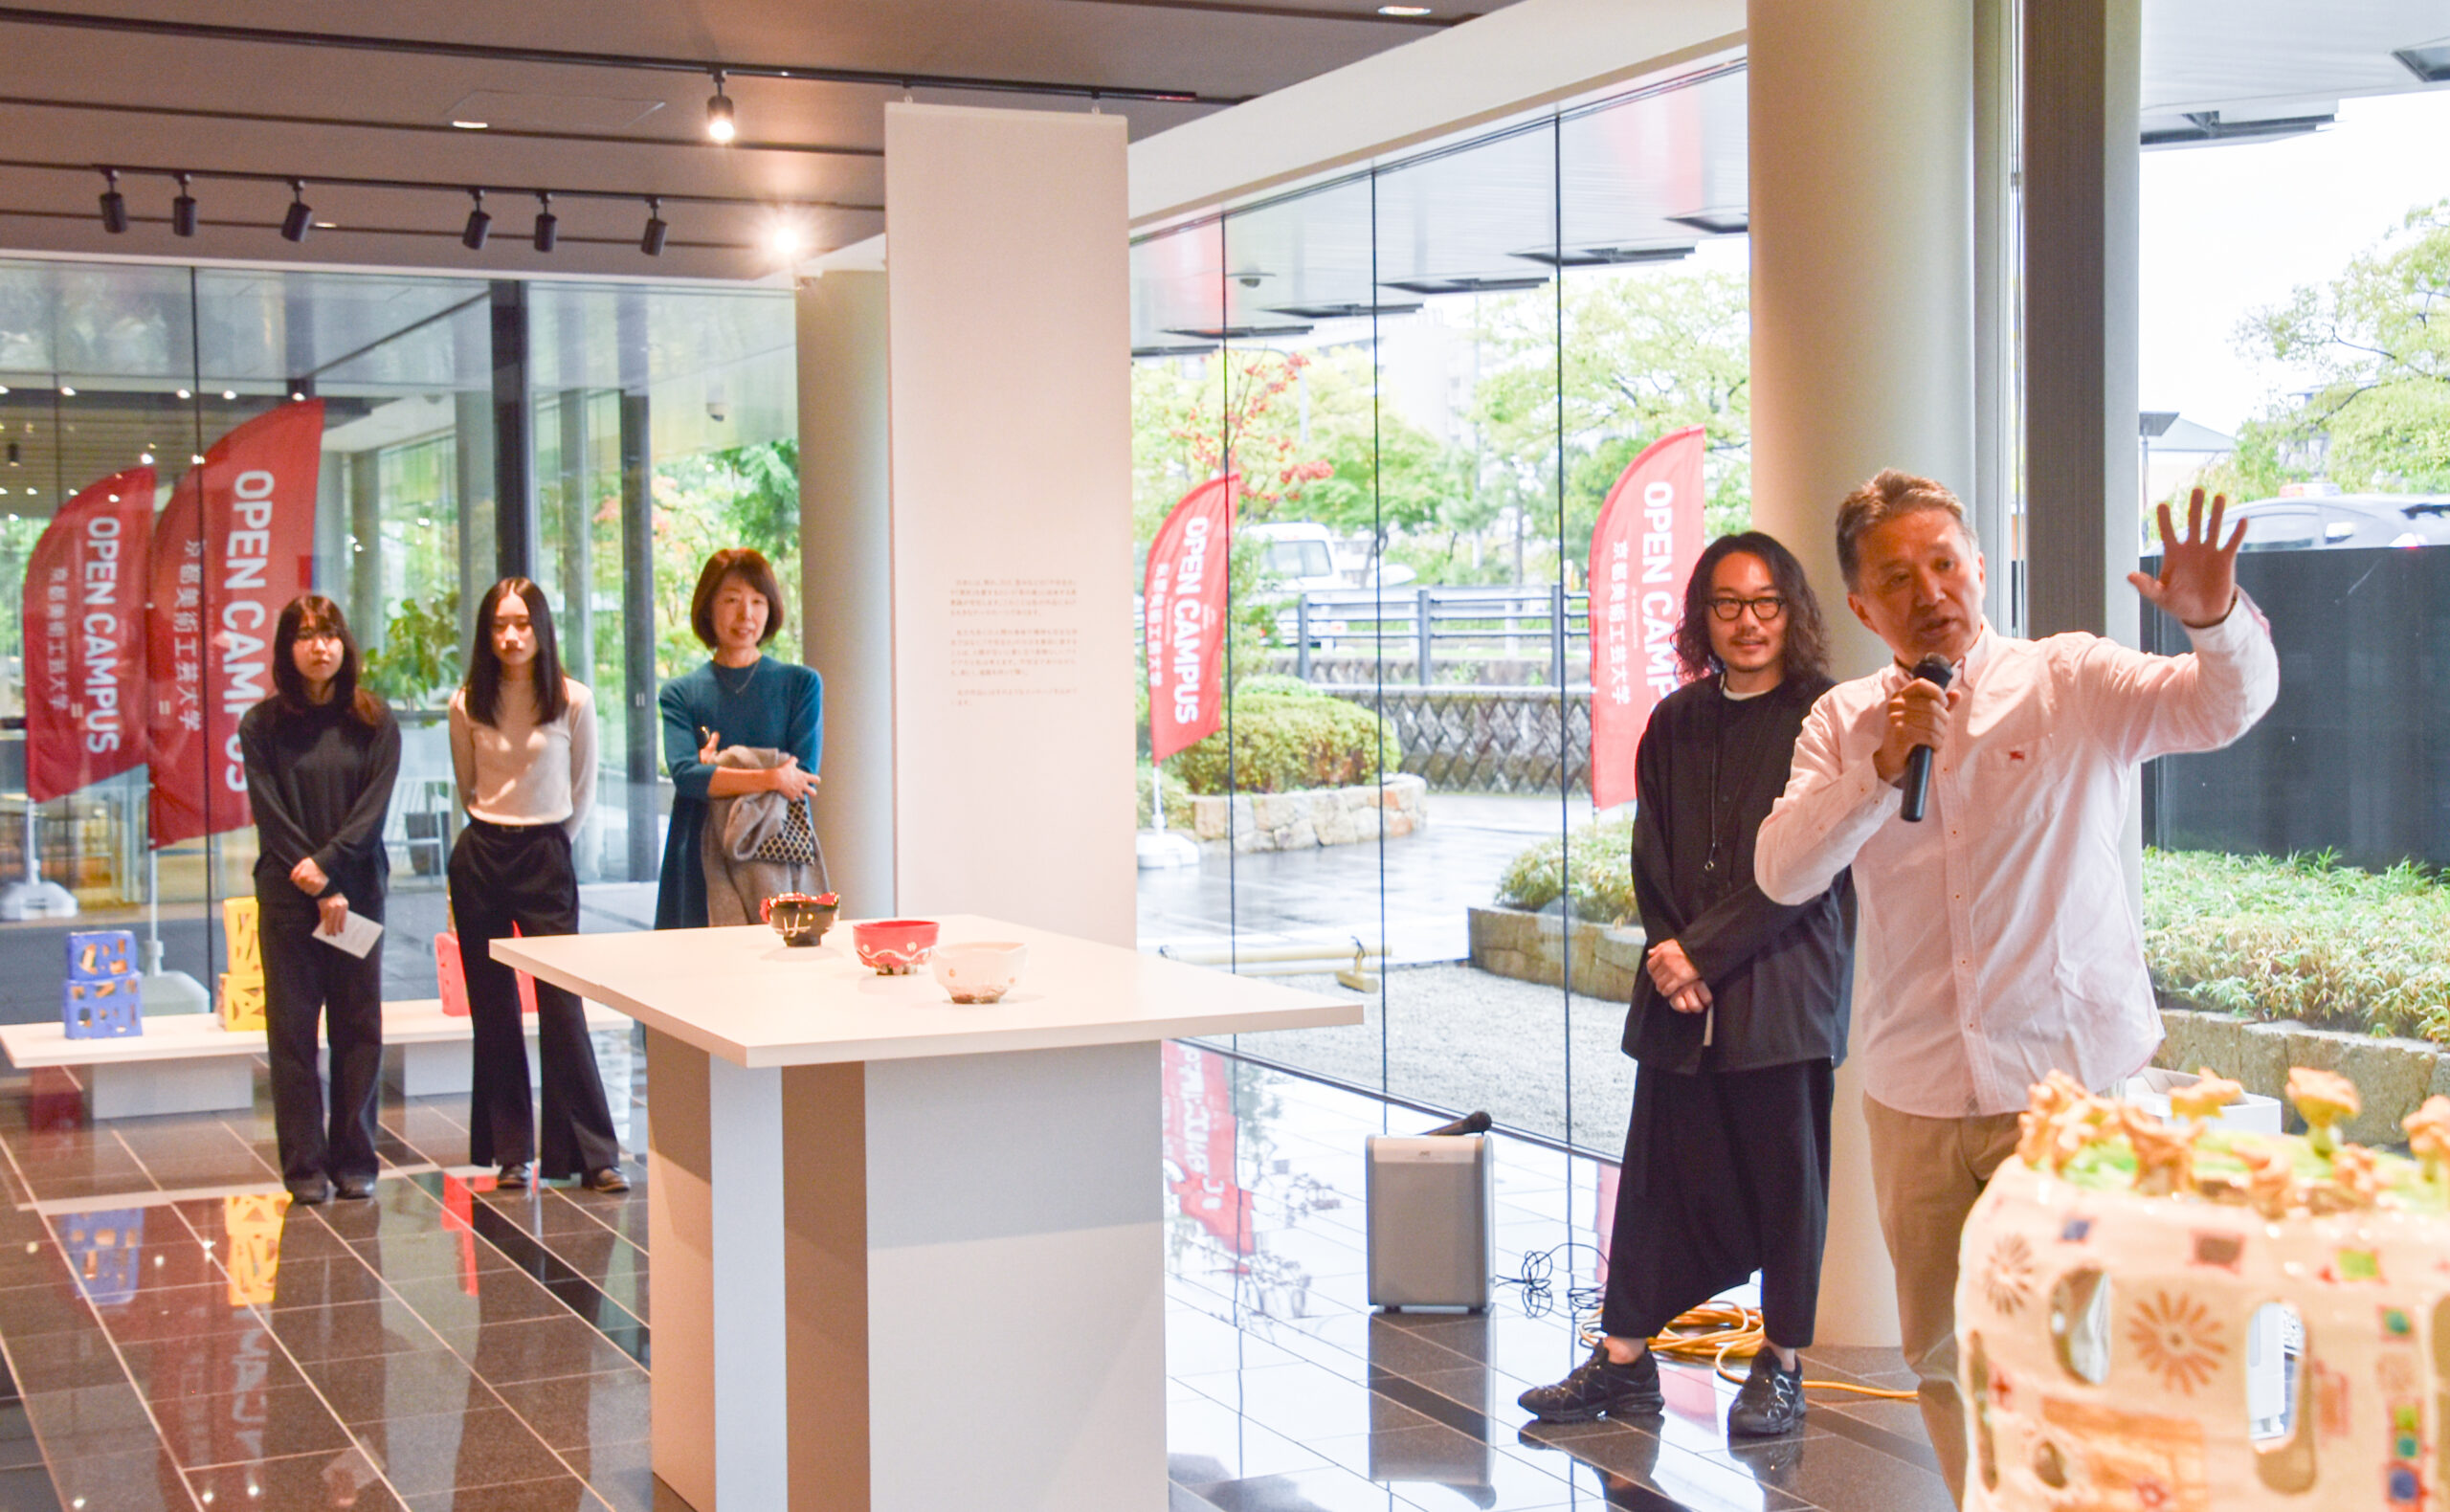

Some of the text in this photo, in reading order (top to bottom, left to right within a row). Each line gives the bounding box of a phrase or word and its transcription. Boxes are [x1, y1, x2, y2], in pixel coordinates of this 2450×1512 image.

[223, 470, 274, 589] OPEN
[1174, 516, 1210, 595] OPEN
[1641, 480, 1681, 712] OPEN CAMP
[83, 517, 121, 753] OPEN CAMPUS
[1173, 598, 1201, 724] CAMPUS
[1609, 540, 1631, 705] 京都美術工芸大学
